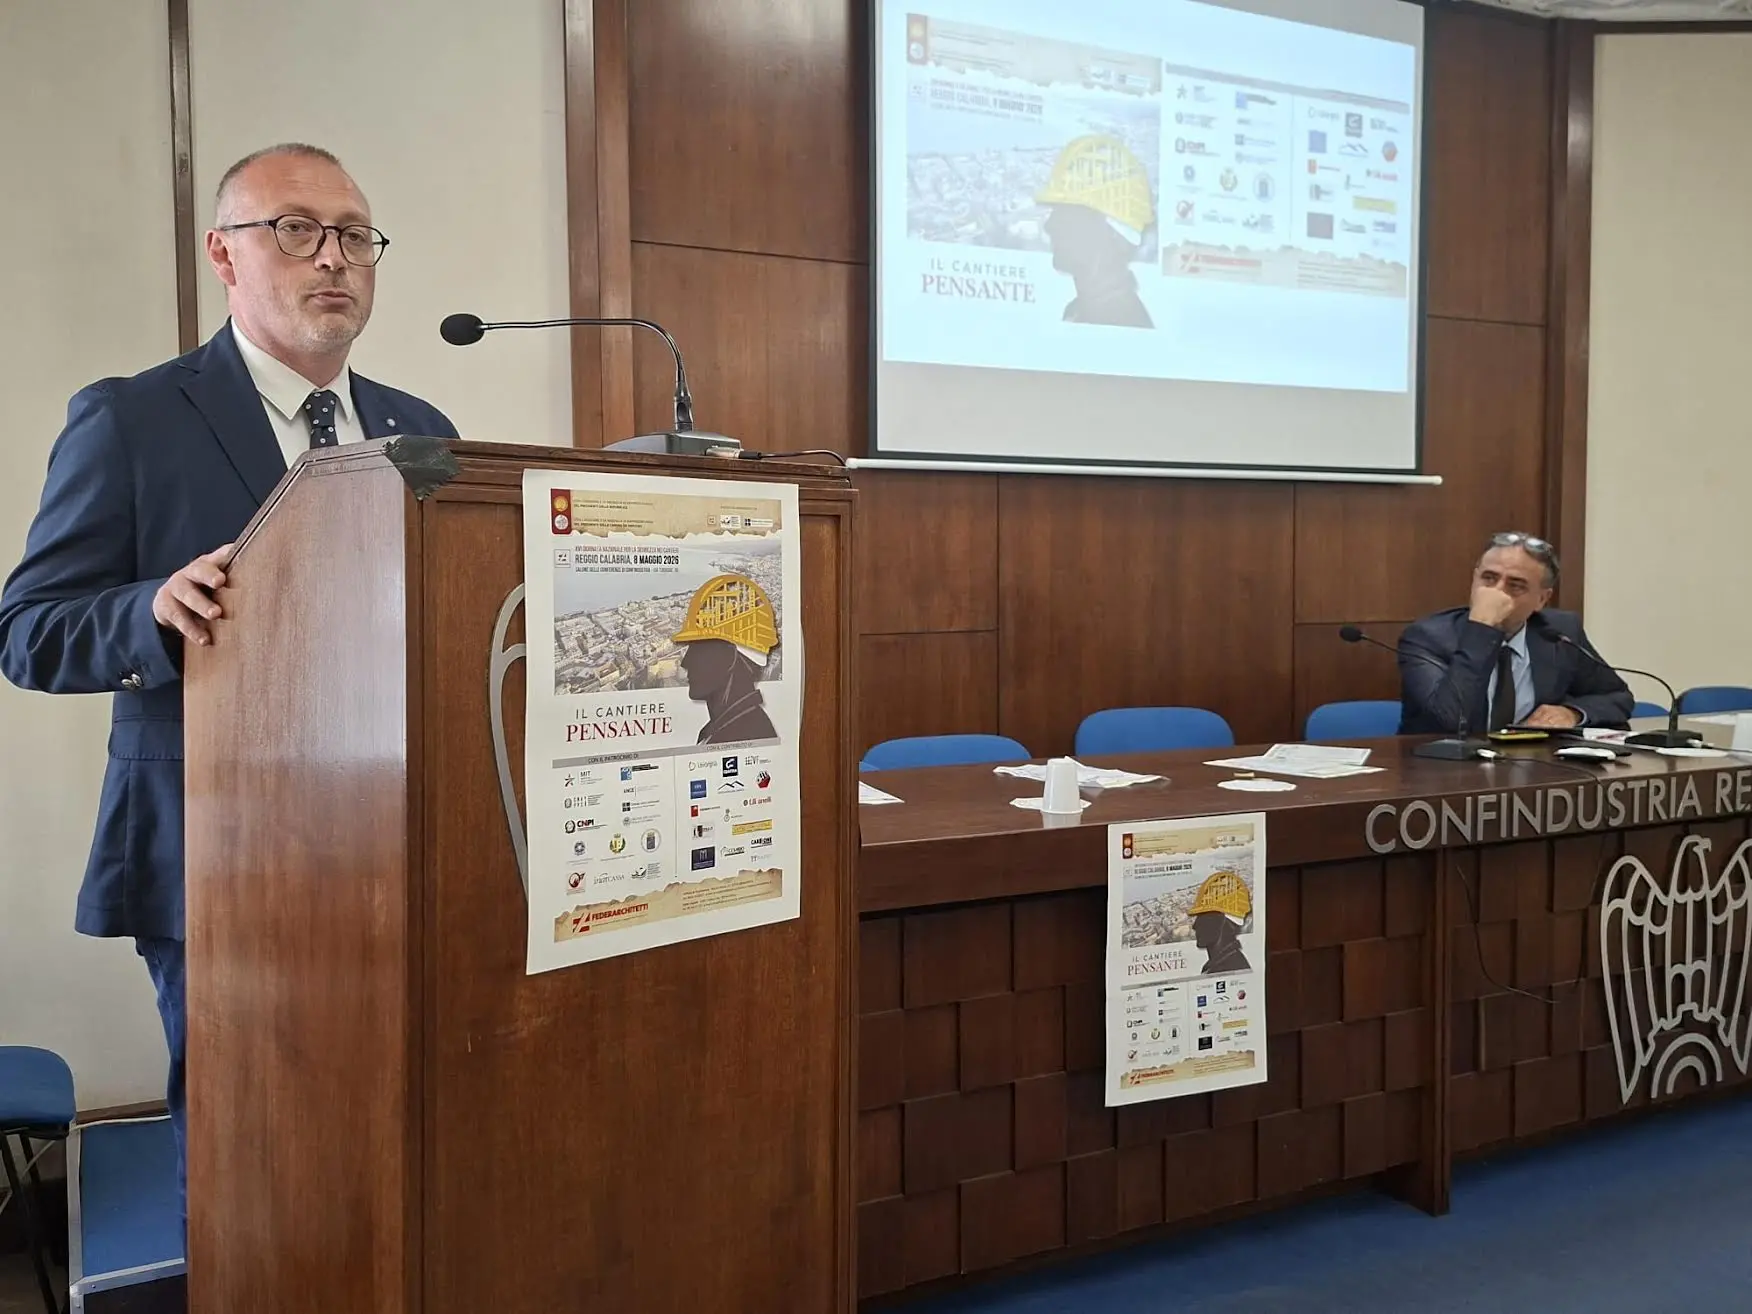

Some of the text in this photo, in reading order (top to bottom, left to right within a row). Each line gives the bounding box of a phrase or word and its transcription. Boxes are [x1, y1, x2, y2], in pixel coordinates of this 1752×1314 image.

[930, 258, 1027, 279] IL CANTIERE
[921, 274, 1036, 304] PENSANTE
[575, 554, 679, 565] REGGIO CALABRIA, 8 MAGGIO 2026
[575, 703, 666, 719] IL CANTIERE
[566, 717, 673, 742] PENSANTE
[1365, 770, 1752, 853] CONFINDUSTRIA RE
[591, 903, 649, 921] FEDERARCHITETTI
[1143, 950, 1183, 961] CANTIERE
[1127, 958, 1188, 976] PENSANTE
